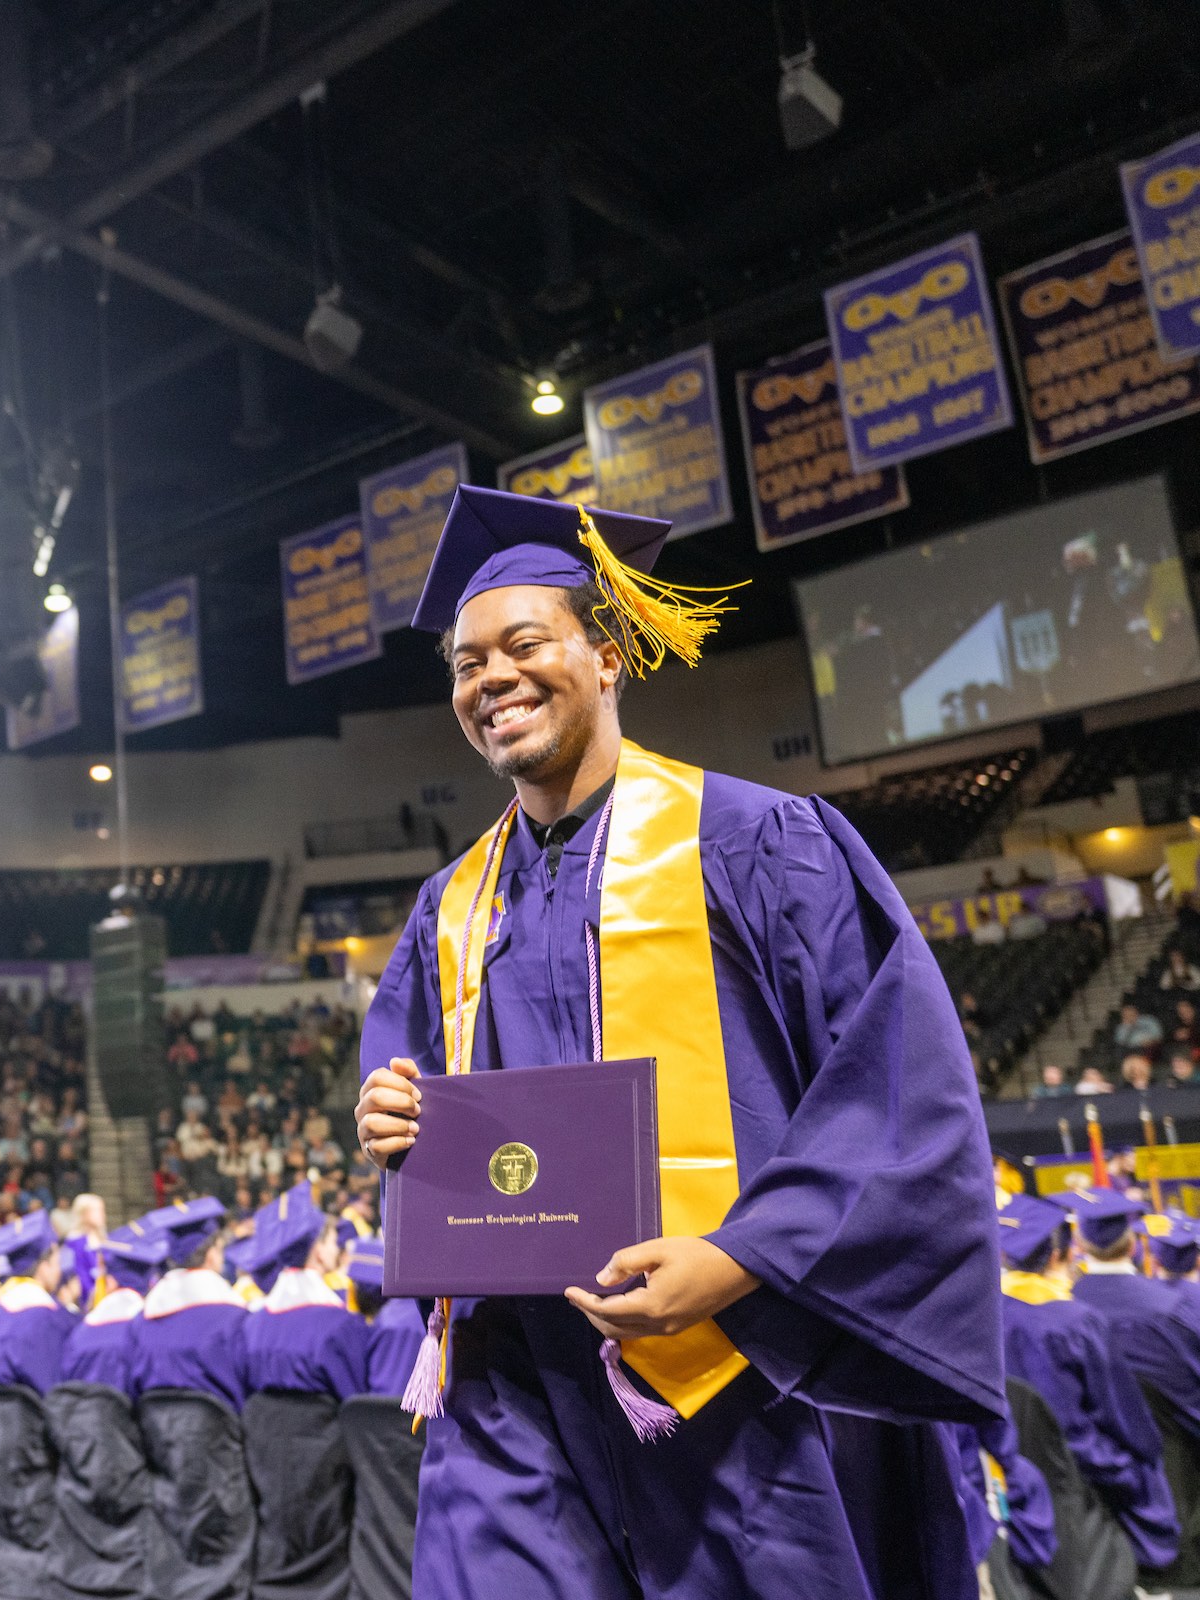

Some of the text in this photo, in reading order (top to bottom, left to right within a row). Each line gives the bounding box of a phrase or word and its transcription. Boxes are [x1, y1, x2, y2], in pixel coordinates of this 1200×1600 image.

[447, 1212, 580, 1226] Tennessee Technological University
